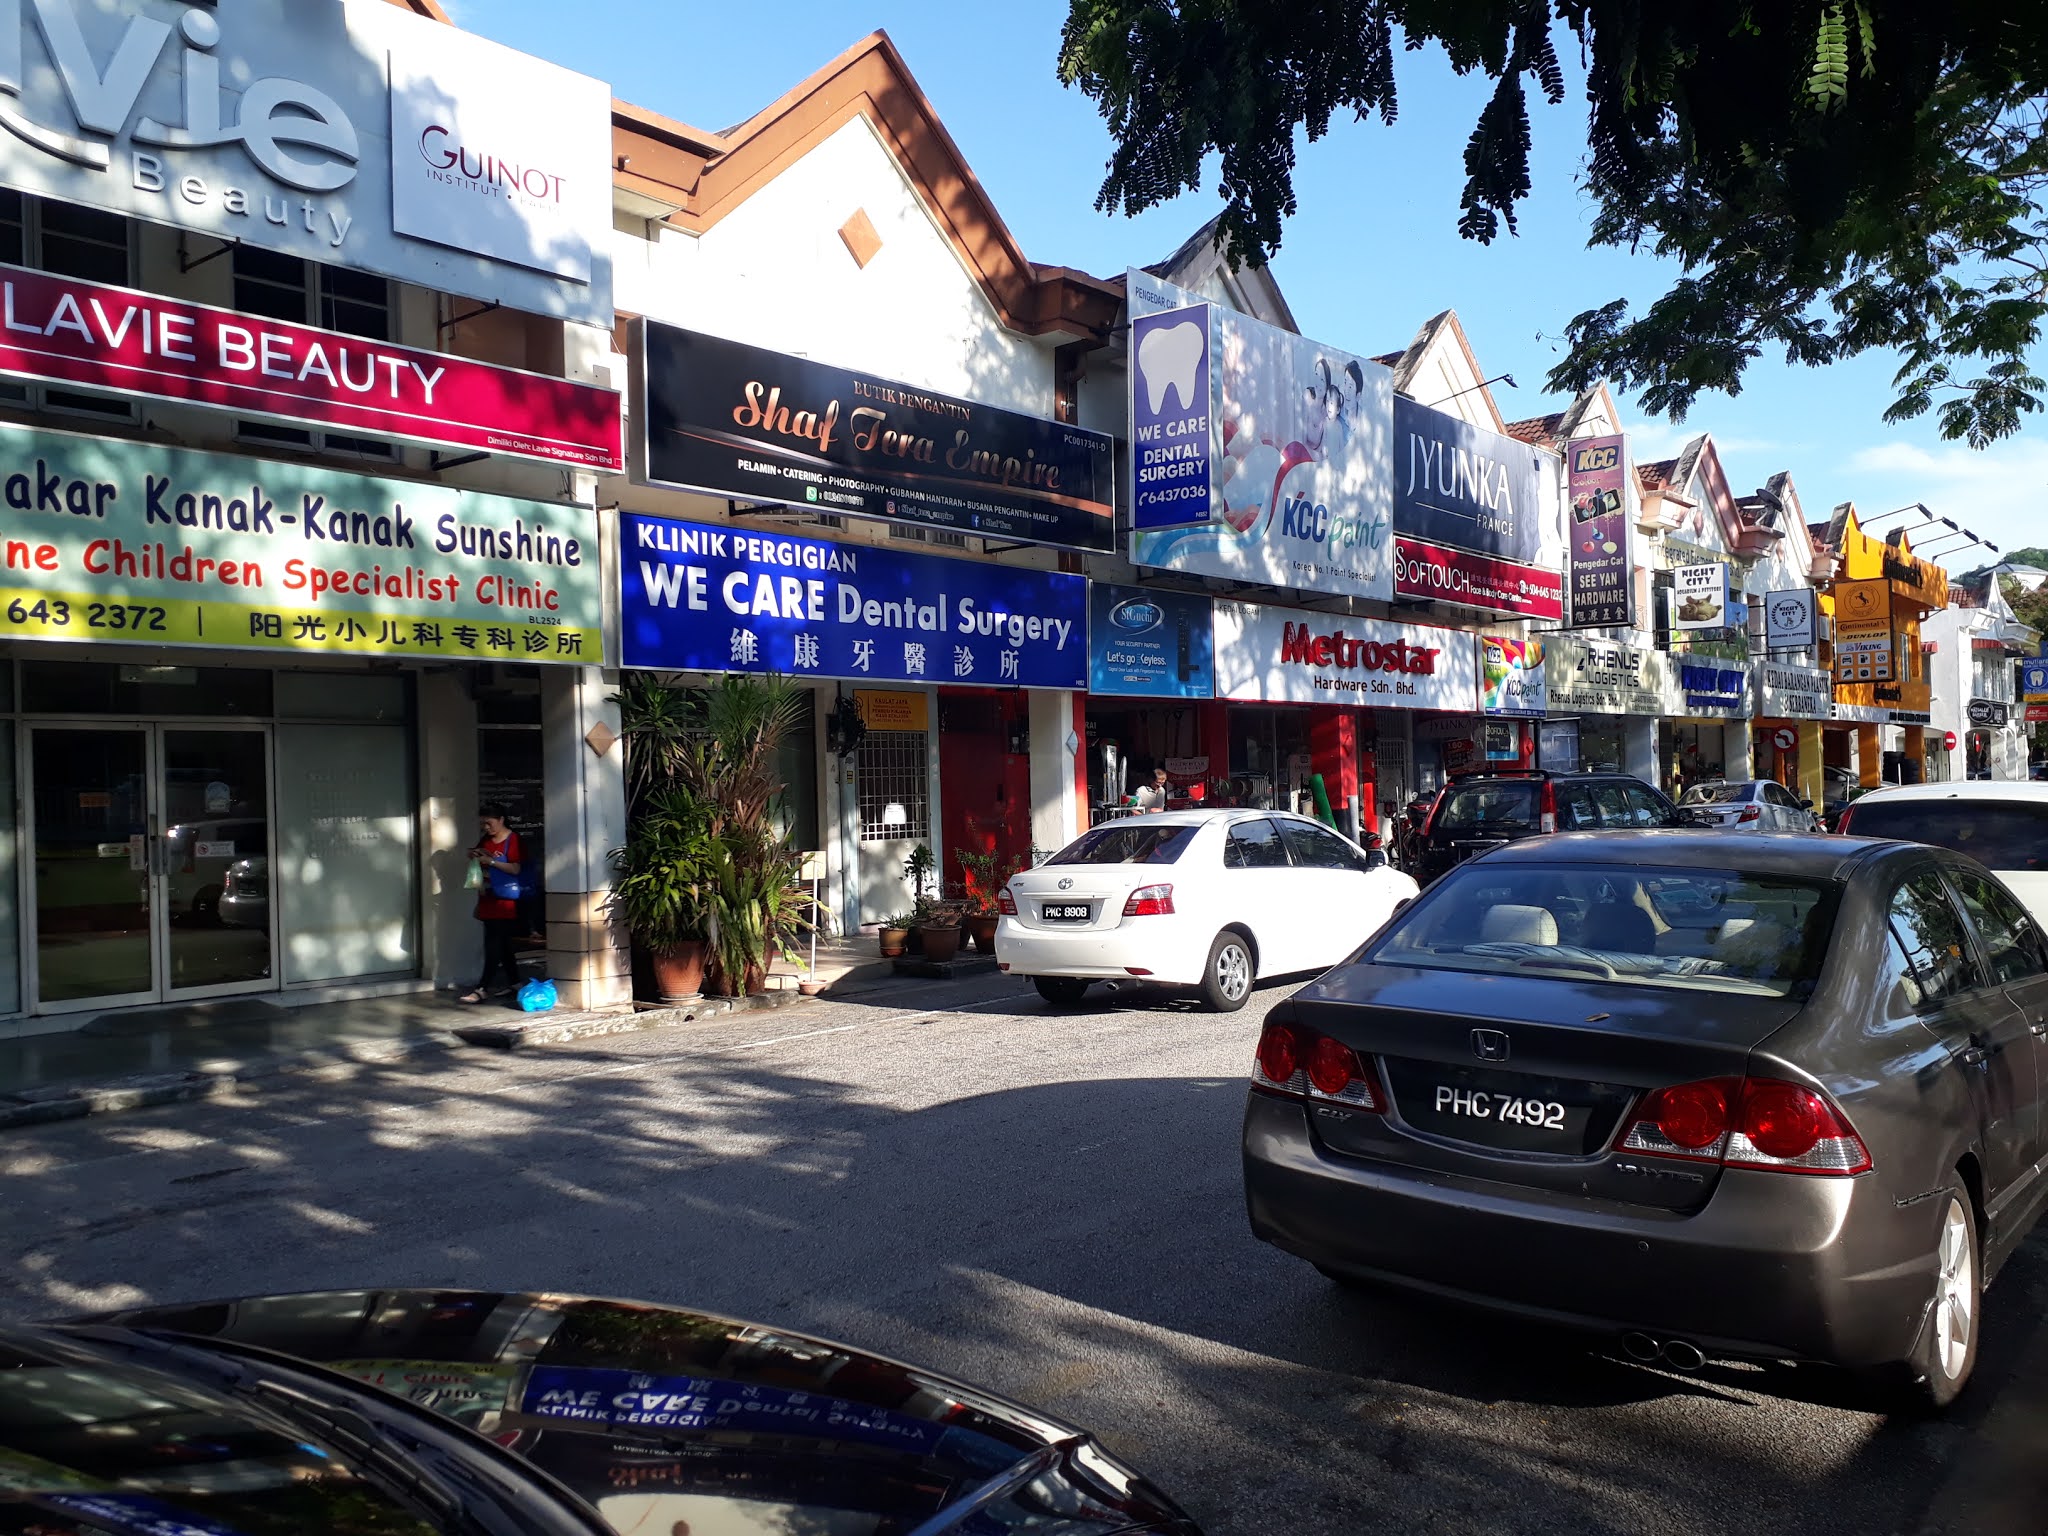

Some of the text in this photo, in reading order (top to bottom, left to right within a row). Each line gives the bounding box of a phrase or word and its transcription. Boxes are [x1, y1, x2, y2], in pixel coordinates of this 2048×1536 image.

[418, 125, 566, 203] GUINOT
[426, 168, 499, 198] INSTITUT
[132, 152, 353, 248] Beauty
[1135, 286, 1165, 308] PENGEDAR
[4, 281, 445, 405] LAVIE BEAUTY
[853, 380, 971, 422] BUTIK PENGANTIN
[733, 381, 1061, 489] Shaf Tera Empire
[1138, 416, 1207, 441] WE CARE
[532, 443, 550, 454] Lavie
[551, 447, 584, 460] Signature
[584, 453, 598, 462] Sdn
[599, 455, 613, 465] Bhd
[1063, 434, 1107, 452] PC0017341-D
[1144, 443, 1200, 465] DENTAL
[1578, 445, 1616, 470] KCC
[1139, 459, 1205, 483] SURGERY
[1406, 433, 1513, 515] JYUNKA
[738, 459, 1059, 524] PELAMIN CATERING PHOTOGRAPHY GUBAHAN HANTARAN BUSANA PENGANTIN MAKE UP
[1148, 485, 1207, 504] 6437036
[146, 475, 415, 549] Kanak-Kanak
[435, 513, 581, 566] Sunshine
[1282, 491, 1386, 561] KCC paint
[1476, 513, 1514, 536] FRANCE
[637, 522, 857, 574] KLINIK PERGIGIAN
[0, 532, 560, 611] ne Children Specialist Clinic
[1292, 560, 1312, 572] Korea
[1314, 564, 1324, 574] No.
[1330, 567, 1346, 577] Paint
[1347, 569, 1377, 581] Specialist
[1395, 546, 1469, 593] SOFTOUCH
[1573, 556, 1624, 570] Pengedar Cat
[1682, 567, 1715, 578] NIGHT
[1580, 572, 1617, 588] SEE YAN
[1686, 577, 1711, 586] CITY
[639, 560, 1072, 651] WE CARE Dental Surgery
[1219, 604, 1238, 613] KEDAI
[1574, 589, 1624, 606] HARDWARE
[7, 598, 167, 630] 643 2372
[529, 615, 562, 626] BL2524
[250, 612, 583, 656] 阳光小儿科专科诊所
[1846, 632, 1887, 640] DUNLOP
[730, 628, 1019, 680] 維康牙醫診所
[1107, 651, 1125, 663] Let's
[1126, 655, 1136, 665] go
[1281, 621, 1440, 676] Metrostar
[1487, 645, 1501, 662] KCC
[1854, 642, 1882, 652] VIKING
[1588, 648, 1640, 670] RHENUS
[1314, 675, 1417, 696] Hardware Sdn. Bhd.
[1506, 676, 1541, 703] KCC paint
[1588, 670, 1639, 687] LOGISTICS
[1550, 689, 1570, 704] Rhenus
[1572, 691, 1595, 708] Logistics
[1045, 906, 1087, 917] PKC 8908
[1435, 1086, 1565, 1131] PHC 7492
